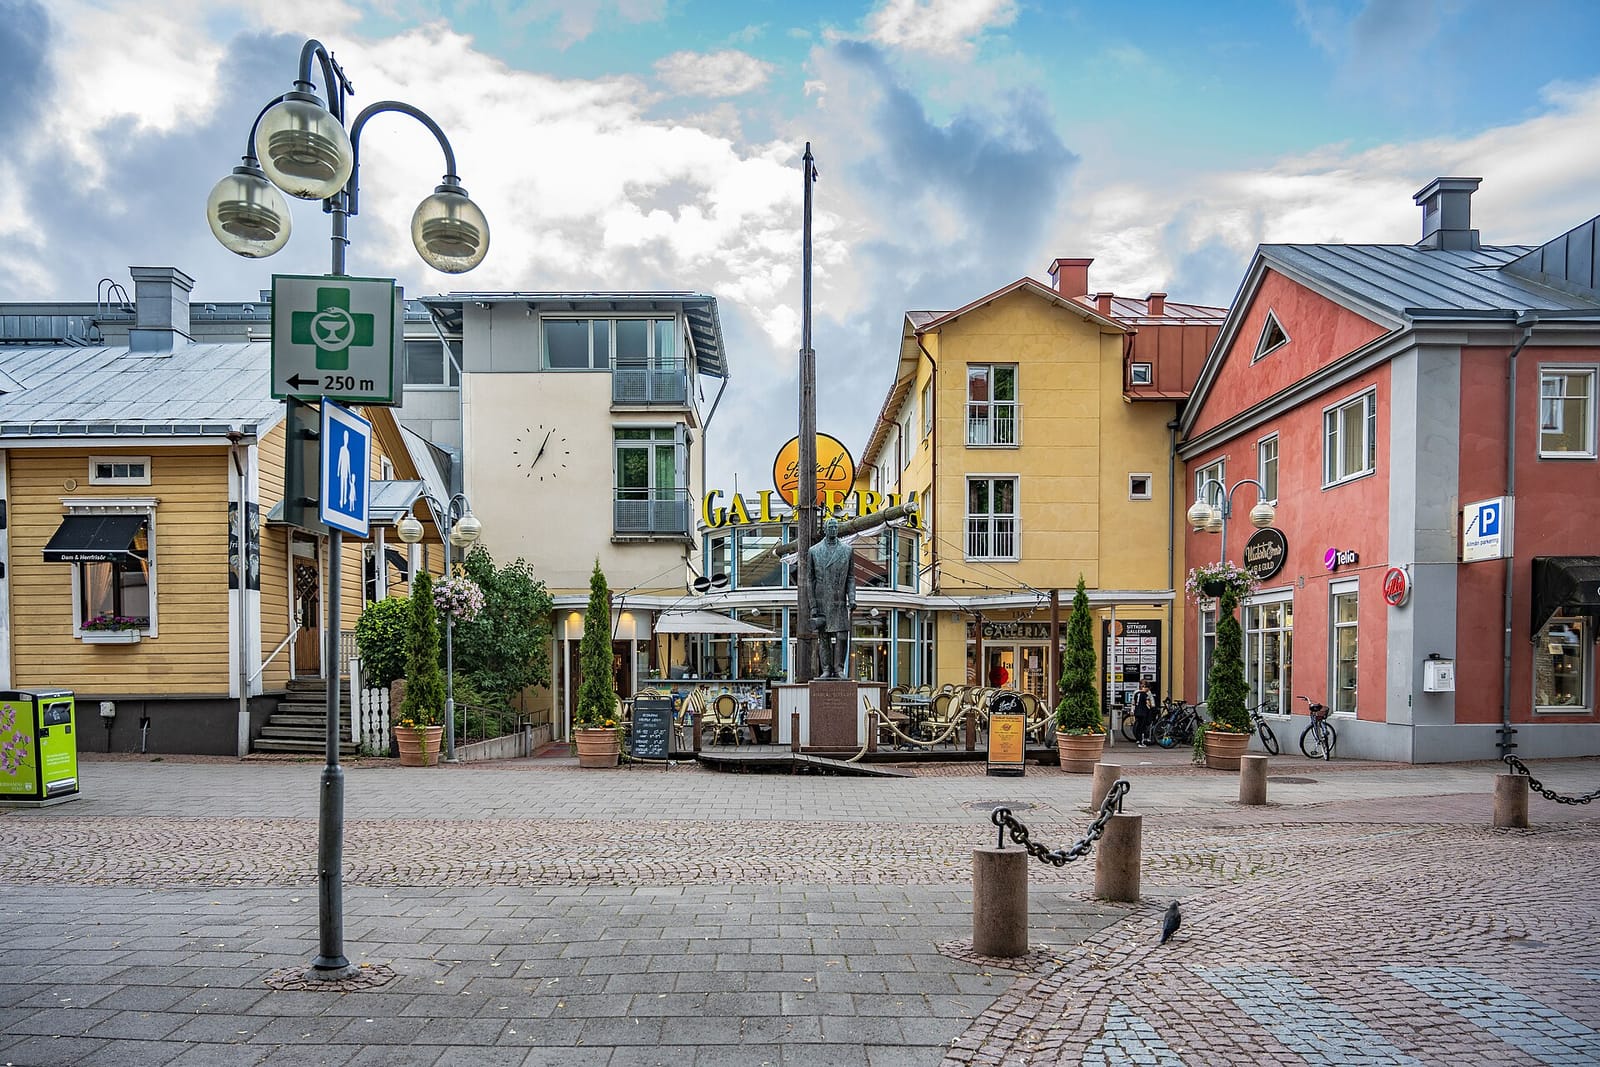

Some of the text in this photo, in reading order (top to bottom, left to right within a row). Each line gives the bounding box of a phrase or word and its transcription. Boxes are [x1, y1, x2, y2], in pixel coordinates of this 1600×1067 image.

[325, 375, 374, 391] 250 m
[1482, 508, 1495, 534] P
[1336, 549, 1355, 565] Telia
[1262, 561, 1275, 571] GULD
[984, 625, 1049, 637] GALLERIA
